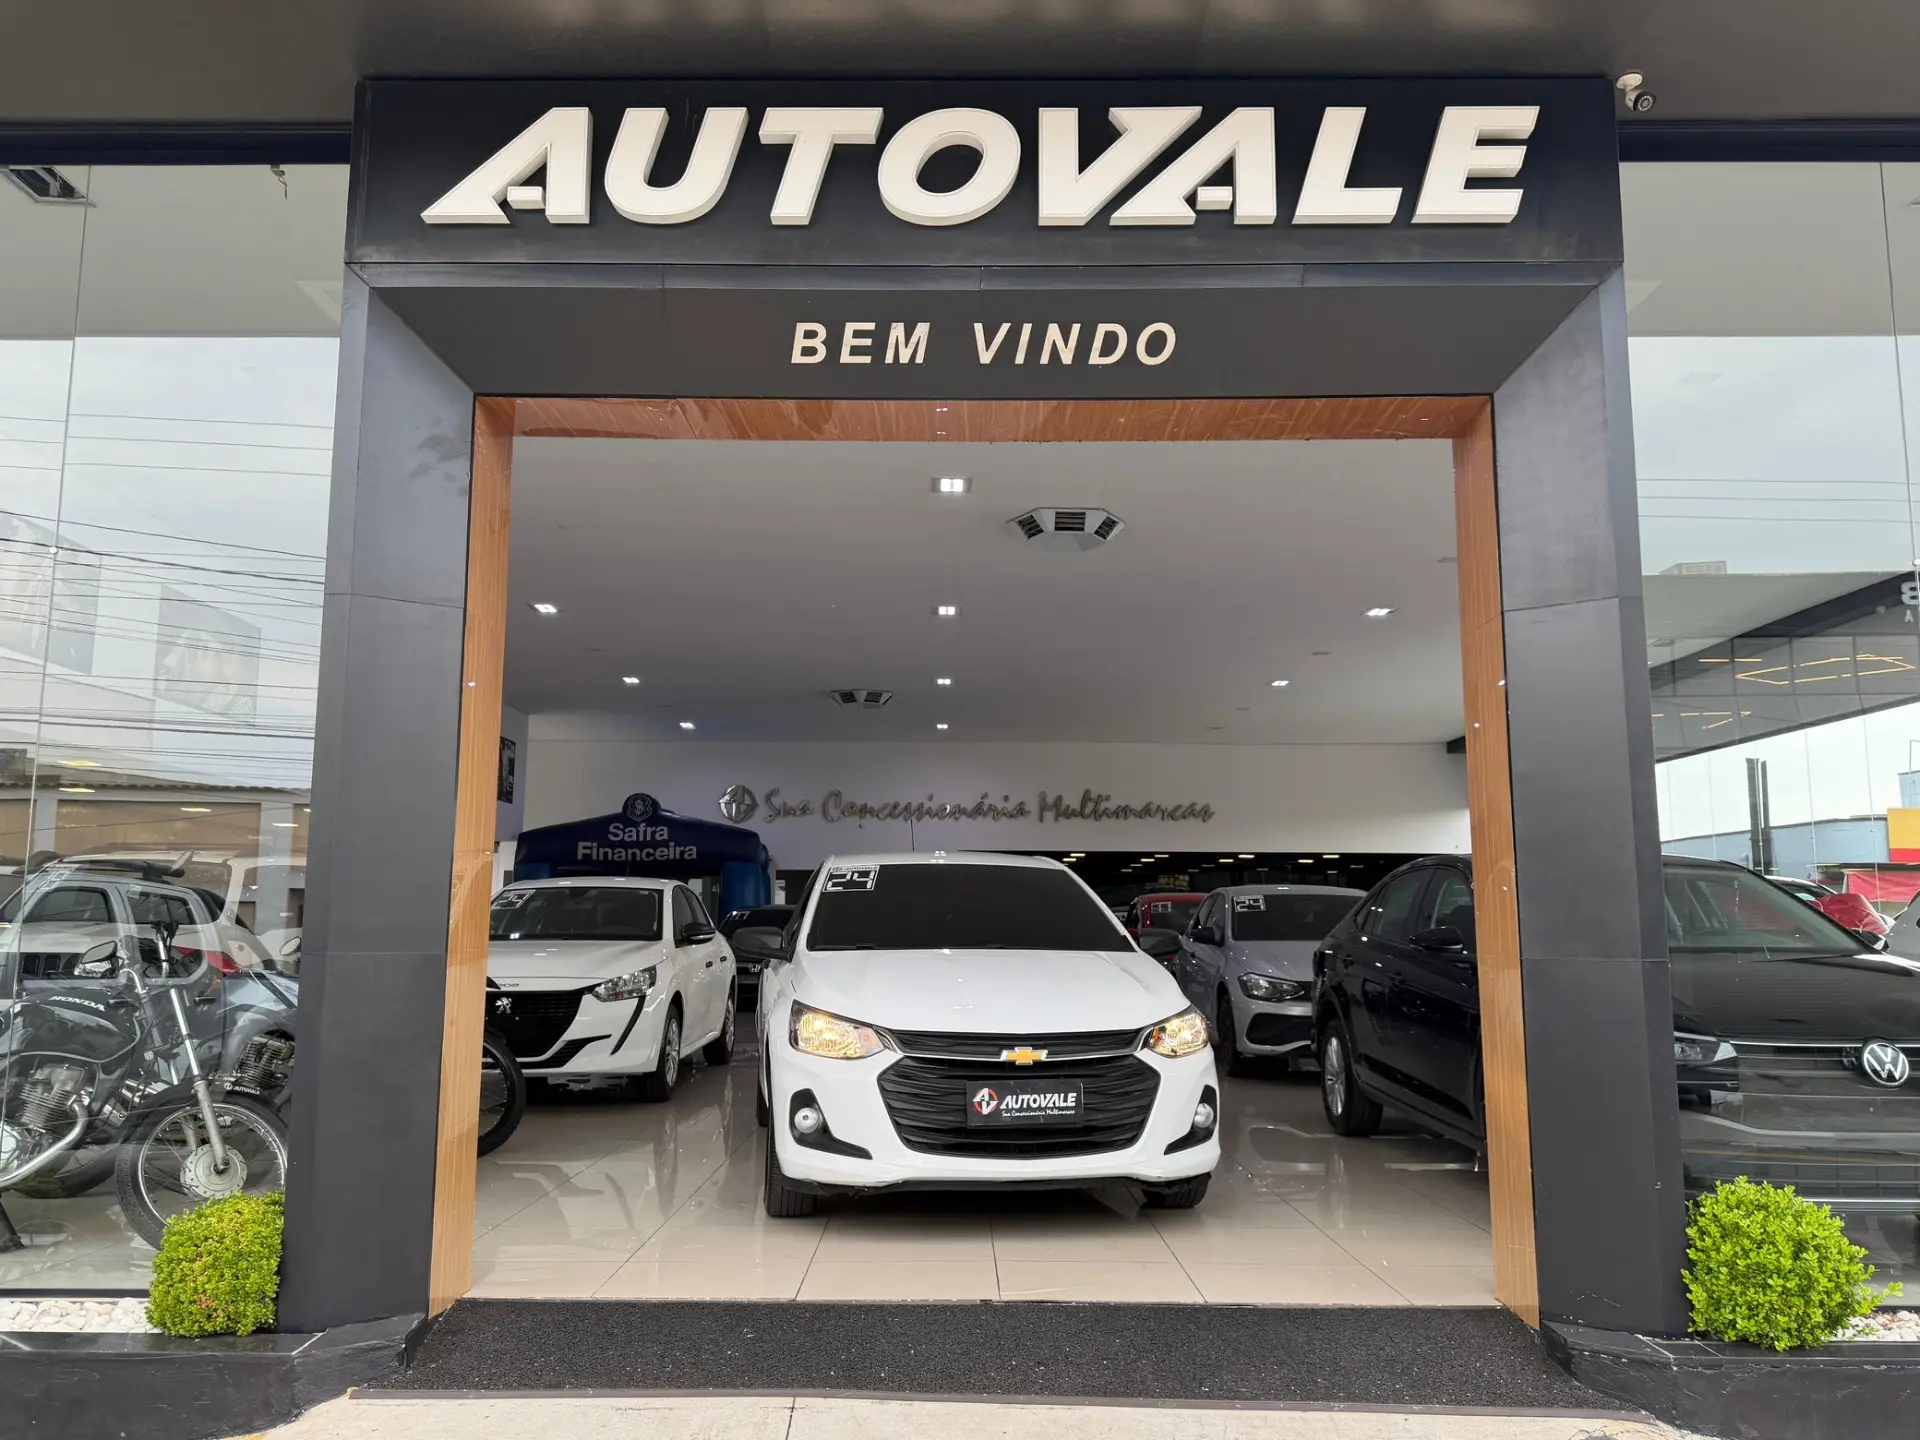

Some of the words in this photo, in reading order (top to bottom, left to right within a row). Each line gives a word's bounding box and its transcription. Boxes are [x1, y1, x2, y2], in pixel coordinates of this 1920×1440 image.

[420, 105, 1540, 228] AUTOVALE
[790, 321, 931, 365] BEM
[972, 321, 1178, 366] VINDO
[764, 787, 815, 823] Sua
[822, 788, 1031, 824] Concessionária
[1037, 788, 1216, 824] Multimarcas
[607, 822, 669, 842] Safra
[576, 841, 697, 861] Financeira
[826, 870, 876, 891] 24
[1236, 898, 1265, 912] 24
[48, 995, 106, 1012] HONDA
[999, 1092, 1077, 1110] AUTOVALE
